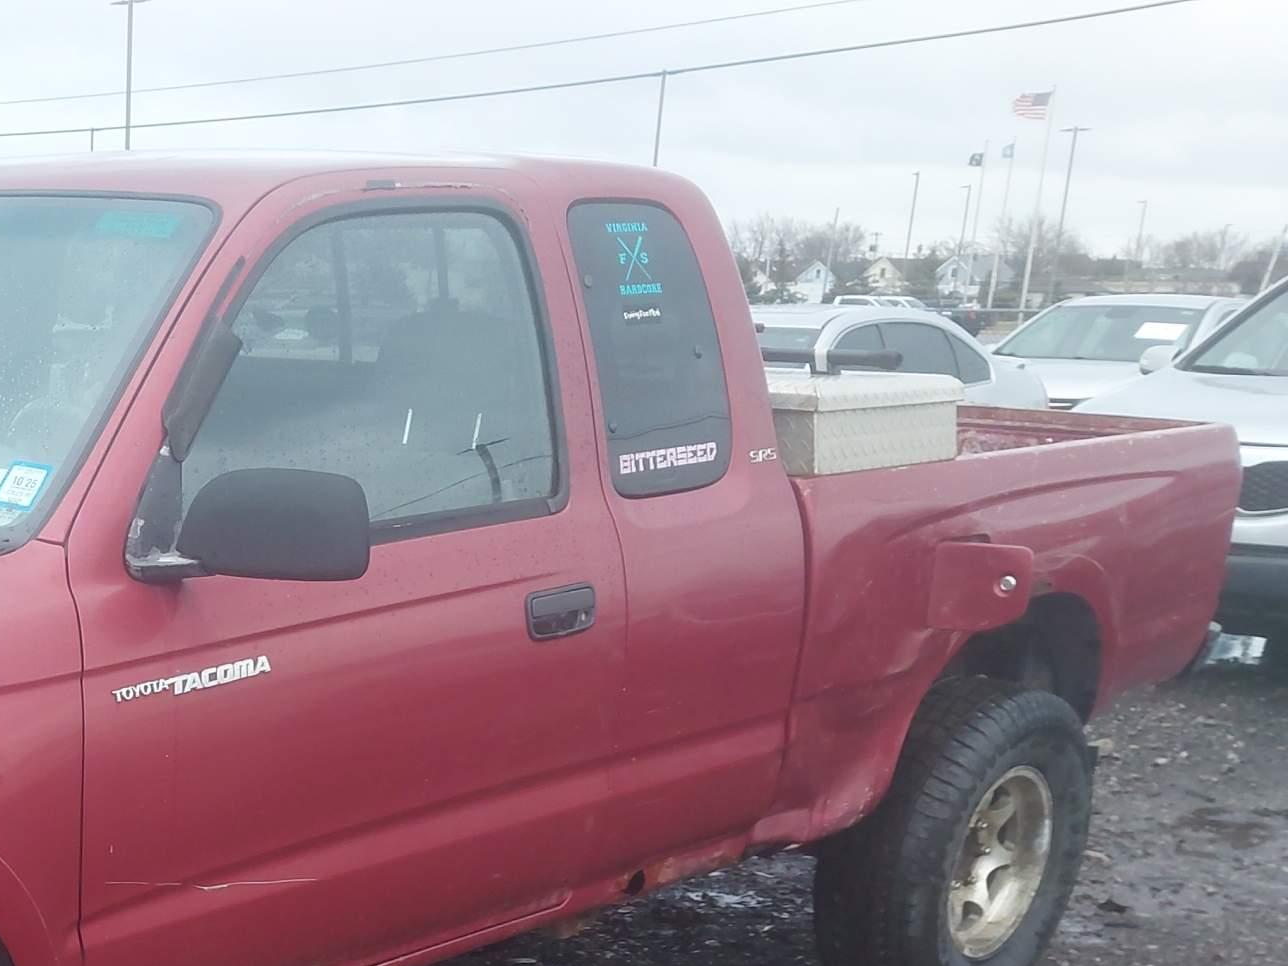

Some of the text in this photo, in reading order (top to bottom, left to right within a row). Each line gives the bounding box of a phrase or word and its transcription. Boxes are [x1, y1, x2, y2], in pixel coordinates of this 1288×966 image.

[605, 223, 648, 233] VIRGINIA
[640, 252, 649, 264] S
[619, 283, 663, 295] HARDCORE
[619, 442, 717, 475] BITTERSEED
[112, 655, 272, 702] TOYOTA TACOMA
